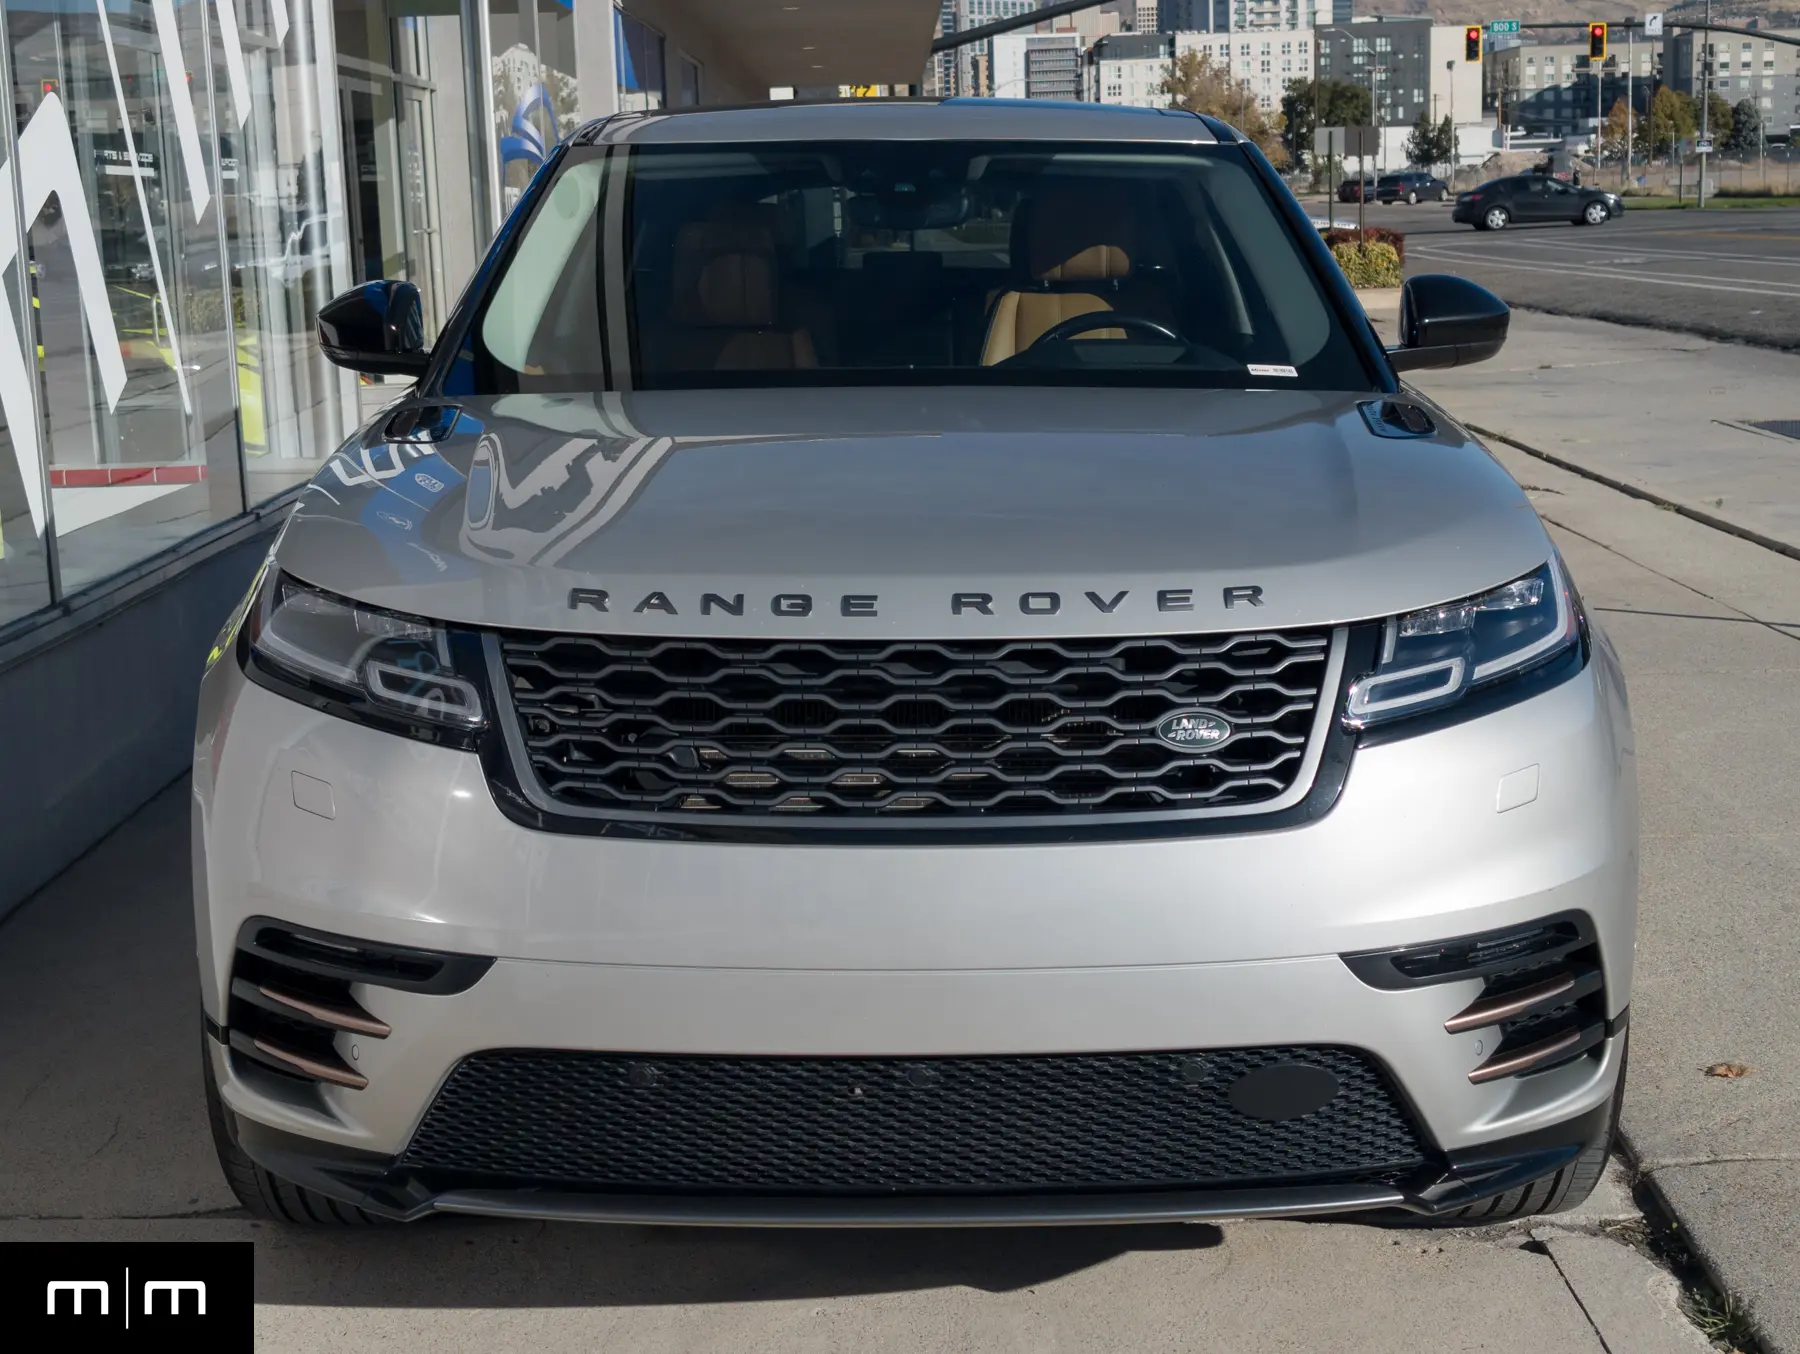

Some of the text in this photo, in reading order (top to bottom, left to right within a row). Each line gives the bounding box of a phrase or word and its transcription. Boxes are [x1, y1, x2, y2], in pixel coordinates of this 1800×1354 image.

[1493, 22, 1517, 32] 800 S
[567, 585, 1266, 617] RANGE ROVER
[1171, 718, 1209, 730] LAND
[1175, 729, 1221, 741] ROVER
